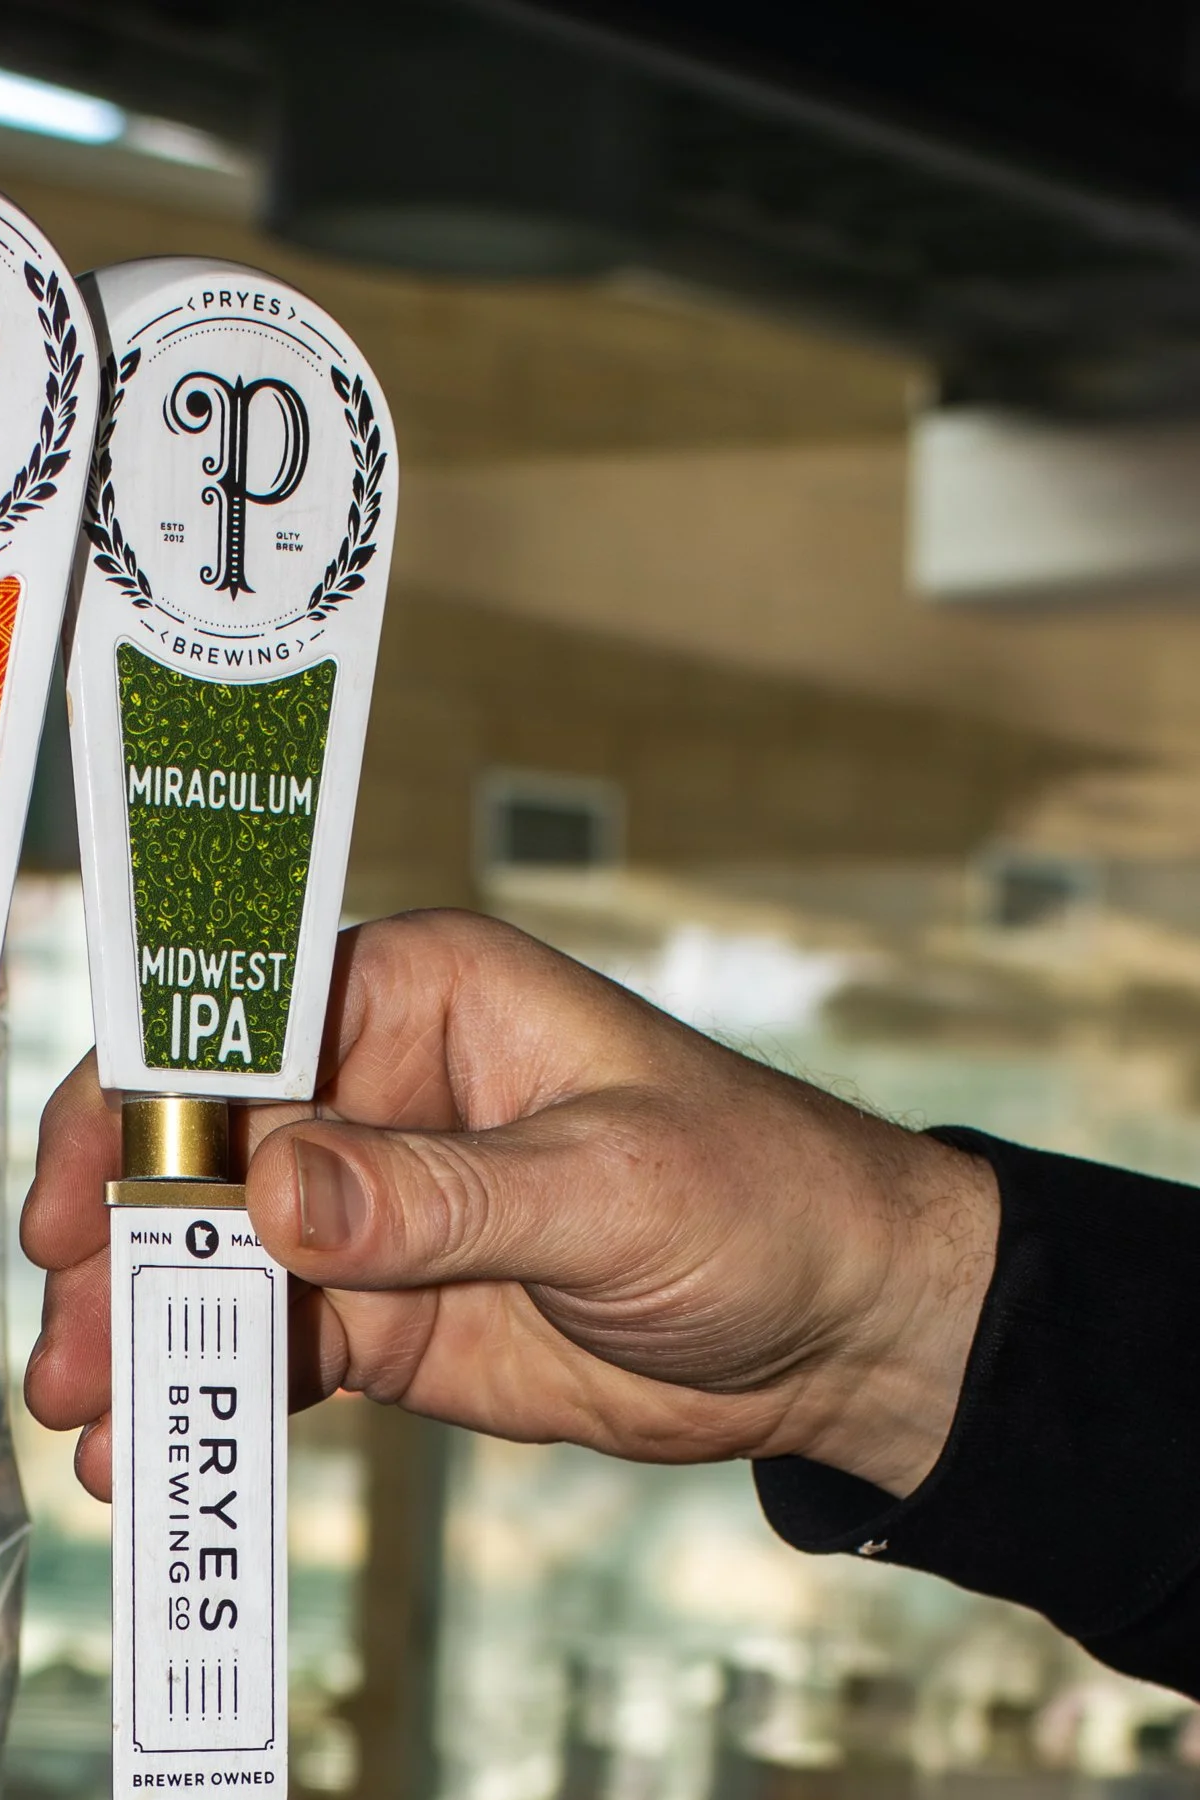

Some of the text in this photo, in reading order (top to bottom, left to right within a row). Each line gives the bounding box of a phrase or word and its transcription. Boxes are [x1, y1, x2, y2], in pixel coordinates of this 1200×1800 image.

[202, 290, 282, 318] PRYES
[160, 522, 185, 532] ESTD
[163, 533, 185, 544] 2012
[276, 531, 300, 542] QLTY
[275, 542, 304, 552] BREW
[172, 637, 291, 668] BREWING
[128, 764, 313, 817] MIRACULUM
[140, 945, 288, 993] MIDWEST
[170, 992, 253, 1065] IPA
[130, 1230, 173, 1245] MINN
[168, 1384, 191, 1631] BREWING CO
[198, 1385, 238, 1632] PRYES
[132, 1770, 276, 1788] BREWER OWNED
